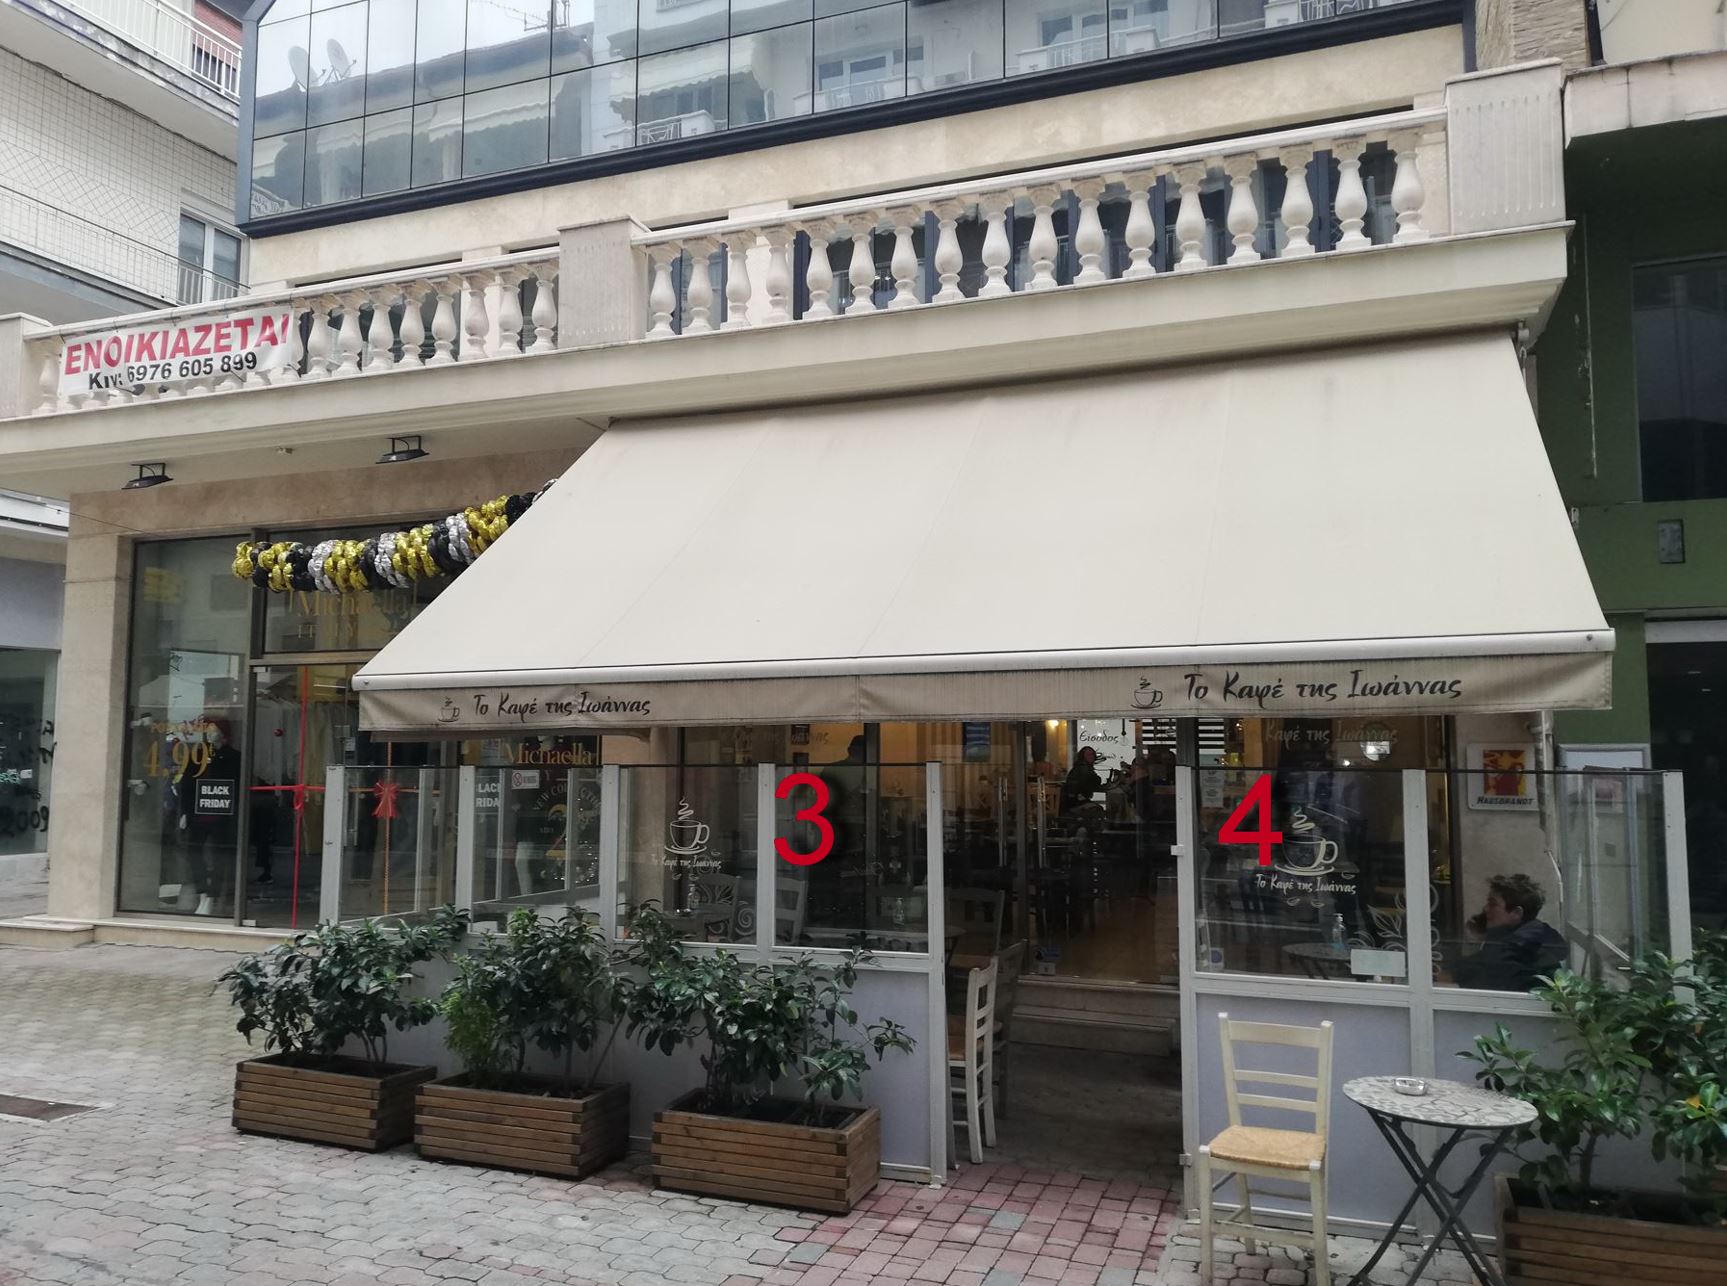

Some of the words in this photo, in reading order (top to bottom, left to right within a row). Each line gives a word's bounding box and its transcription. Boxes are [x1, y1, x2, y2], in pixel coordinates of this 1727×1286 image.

[65, 313, 290, 375] ΕΝΟΙΚΙΑΖΕΤΑΙ
[127, 362, 172, 383] 6976
[179, 357, 213, 378] 605
[220, 351, 258, 372] 899
[1184, 673, 1208, 700] Το
[1223, 671, 1284, 709] Καφέ
[1296, 681, 1337, 701] της
[1347, 669, 1462, 698] Ιωάννας
[473, 694, 489, 715] Το
[497, 691, 538, 723] Καφέ
[545, 702, 573, 716] της
[577, 691, 650, 715] Ιωάννας
[503, 742, 593, 765] Michaella
[201, 786, 230, 795] BLACK
[477, 782, 501, 793] LAC
[200, 799, 231, 809] FRIDAY
[475, 797, 500, 808] RIDA
[1256, 873, 1266, 889] Το
[1297, 881, 1313, 892] της
